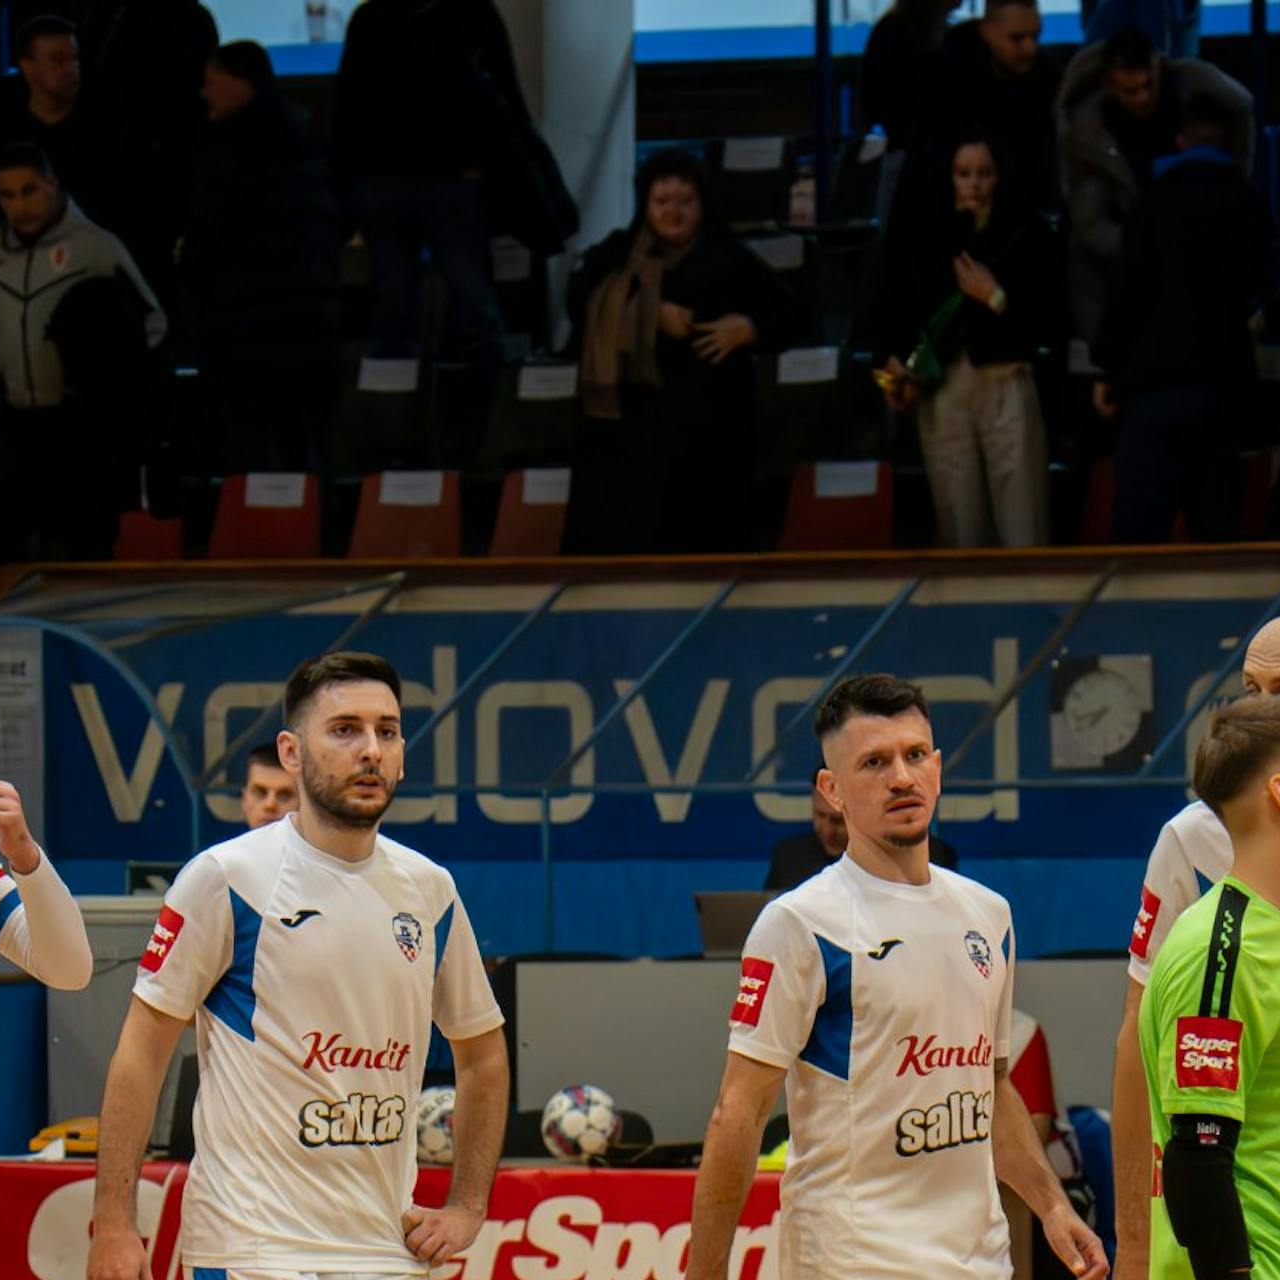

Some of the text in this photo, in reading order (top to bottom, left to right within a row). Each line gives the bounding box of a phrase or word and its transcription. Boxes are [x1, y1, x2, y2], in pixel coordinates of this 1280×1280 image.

[301, 1030, 412, 1074] Kandit
[1179, 1032, 1238, 1053] Super
[1181, 1050, 1235, 1071] Sport
